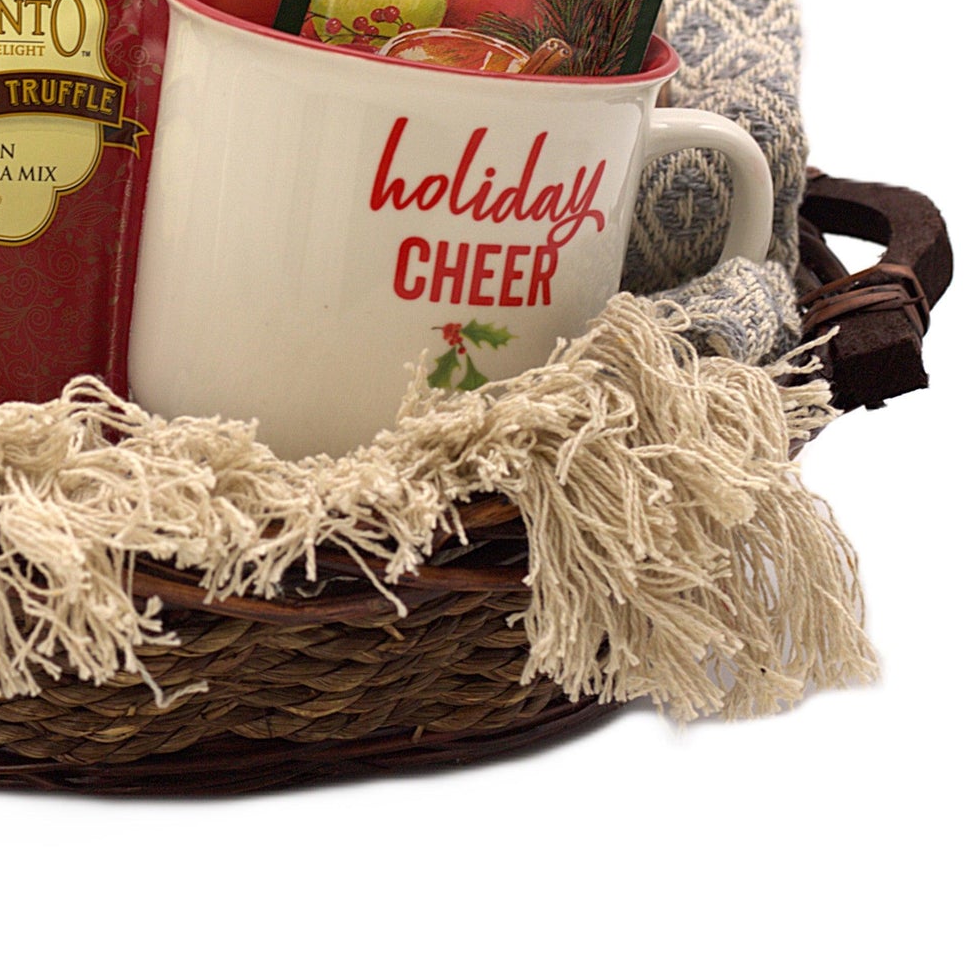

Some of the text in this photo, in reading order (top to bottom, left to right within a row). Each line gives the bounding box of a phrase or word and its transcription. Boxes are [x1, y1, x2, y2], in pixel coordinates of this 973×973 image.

[4, 79, 118, 115] TRUFFLE
[18, 166, 58, 182] MIX
[370, 116, 607, 249] holiday
[393, 236, 559, 307] CHEER
